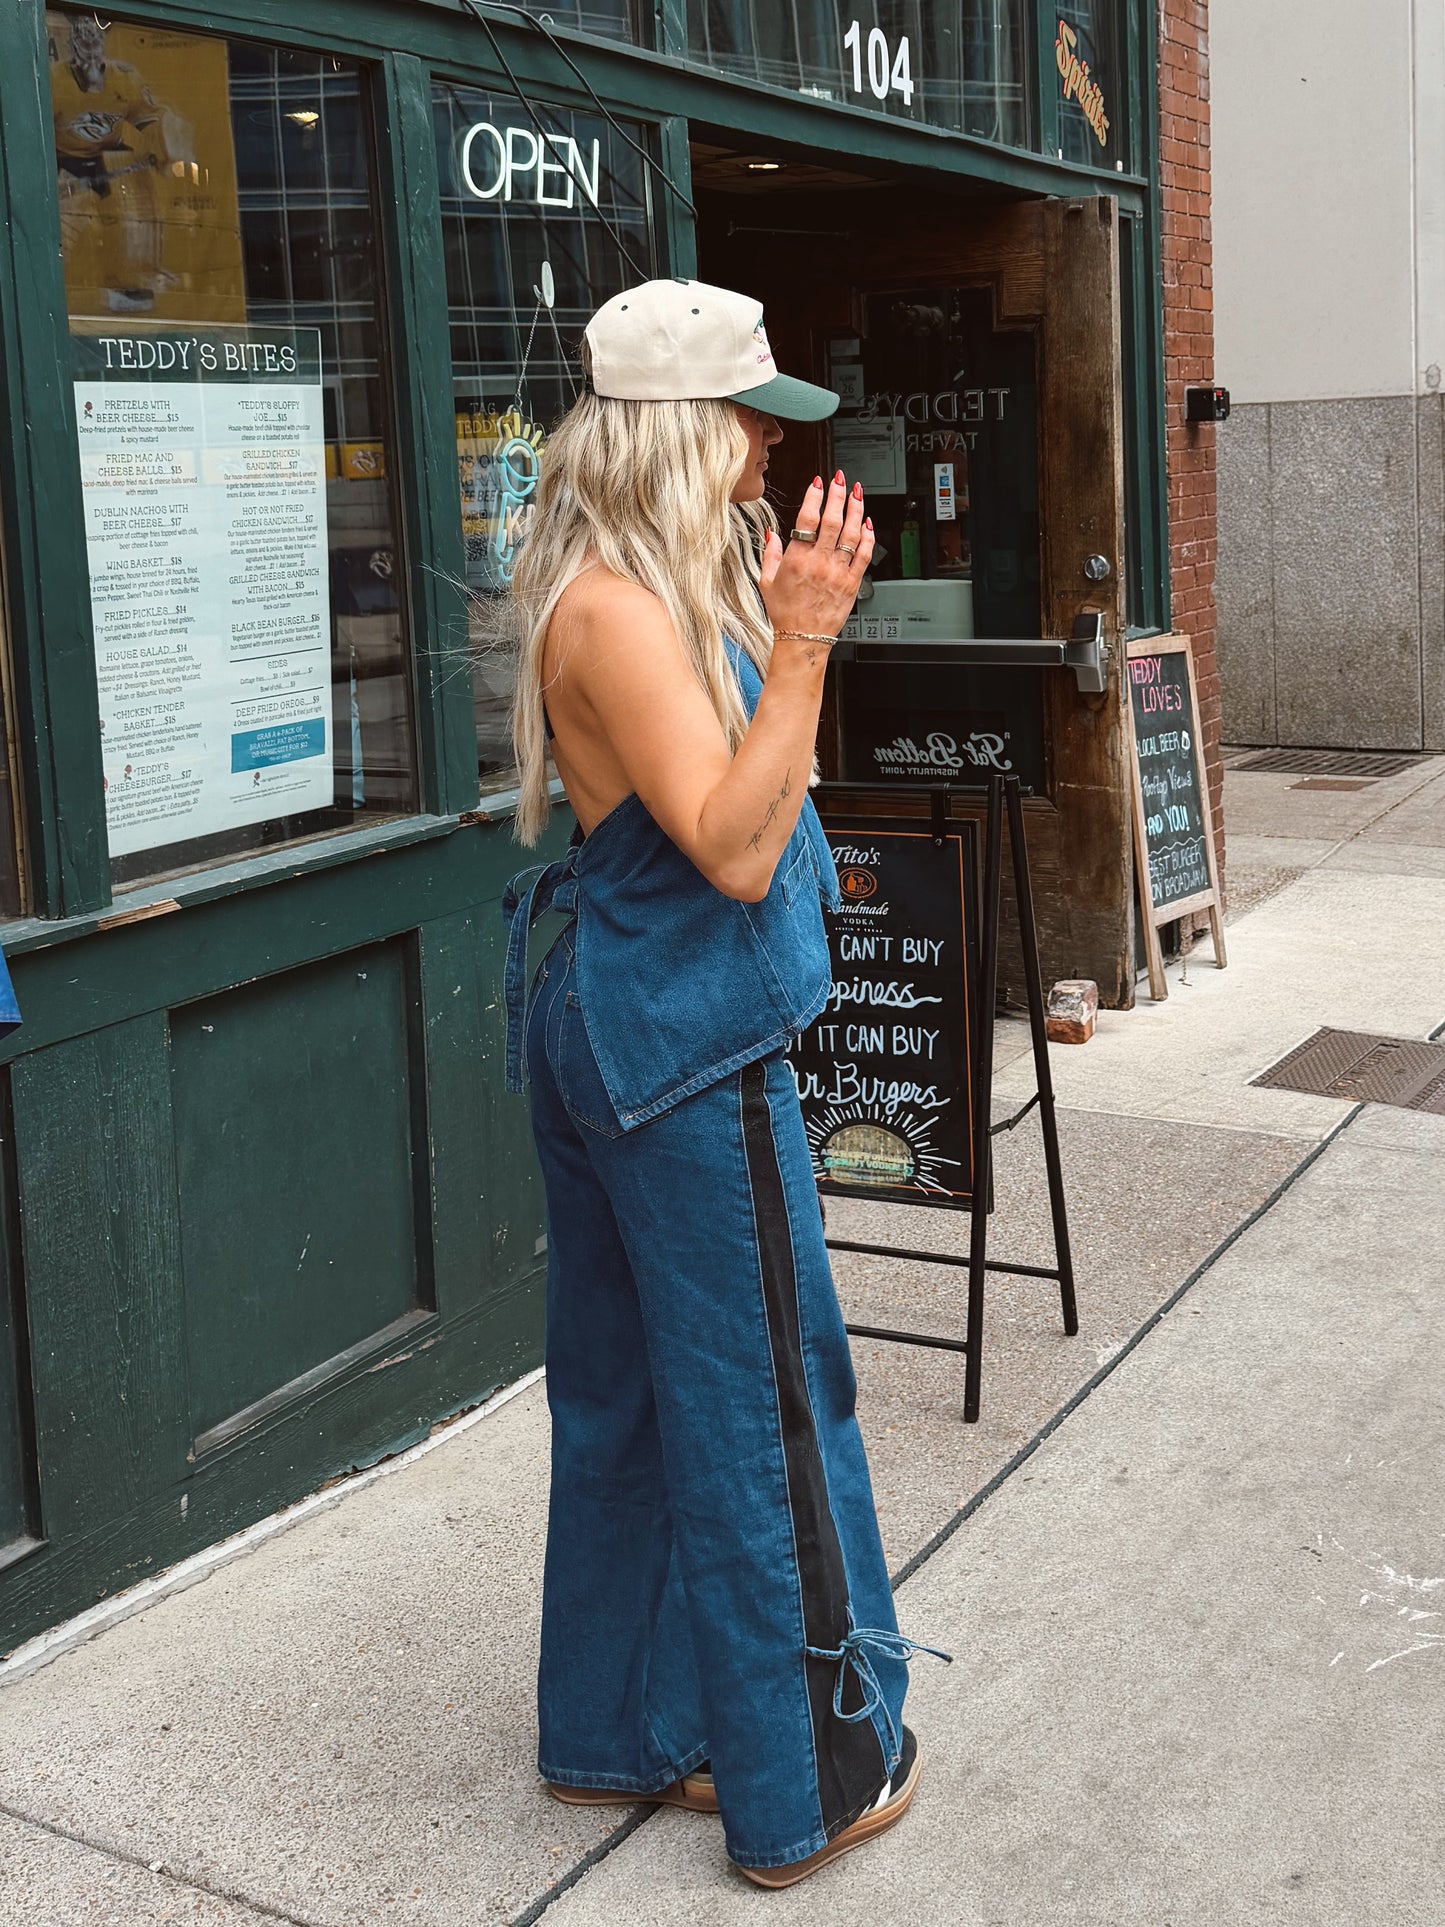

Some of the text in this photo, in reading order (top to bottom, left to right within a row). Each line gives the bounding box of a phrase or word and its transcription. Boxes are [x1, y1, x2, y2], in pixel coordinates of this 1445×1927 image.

[844, 20, 914, 106] 104
[1056, 20, 1110, 147] Spirits
[463, 123, 600, 209] OPEN
[99, 338, 296, 372] TEDDY'S BITES
[843, 384, 854, 393] 26
[105, 401, 170, 410] PRETZELS WITH
[273, 401, 300, 410] SLOPPY
[97, 414, 120, 423] BEER
[106, 453, 174, 463] FRIED MAC AND
[242, 449, 300, 459] GRILLED CHICKEN
[98, 467, 134, 477] CHEESE
[94, 504, 189, 518] DUBLIN NACHOS WITH
[242, 504, 304, 516] HOT OR NOT FRIED
[103, 520, 127, 530] BEER
[232, 519, 262, 528] CHICKEN
[106, 561, 129, 571] WING
[229, 568, 320, 585] GRILLED CHEESE SANDWICH
[248, 586, 264, 595] WITH
[105, 611, 131, 622] FRIED
[232, 622, 256, 633] BLACK
[258, 619, 278, 630] BEAN
[848, 627, 857, 635] 21
[868, 626, 877, 635] 22
[888, 626, 897, 635] 23
[107, 649, 139, 662] HOUSE
[268, 659, 288, 670] SIDES
[1127, 658, 1162, 685] TEDDY
[1142, 684, 1182, 713] LOVES
[154, 702, 186, 714] TENDER
[236, 707, 256, 718] DEEP
[257, 702, 279, 714] FRIED
[1137, 731, 1180, 758] LOCAL BEER
[1167, 765, 1193, 791] Views
[1164, 805, 1191, 833] YOU!
[1171, 845, 1203, 872] BURGER
[1151, 881, 1163, 901] ON
[827, 901, 889, 915] andmade
[843, 918, 874, 926] VODKA
[840, 934, 945, 967] CAN'T BUY
[828, 976, 942, 1012] ppiness
[818, 1025, 839, 1053] IT
[846, 1024, 884, 1054] CAN
[893, 1025, 940, 1060] BUY
[827, 1061, 951, 1116] Burgers
